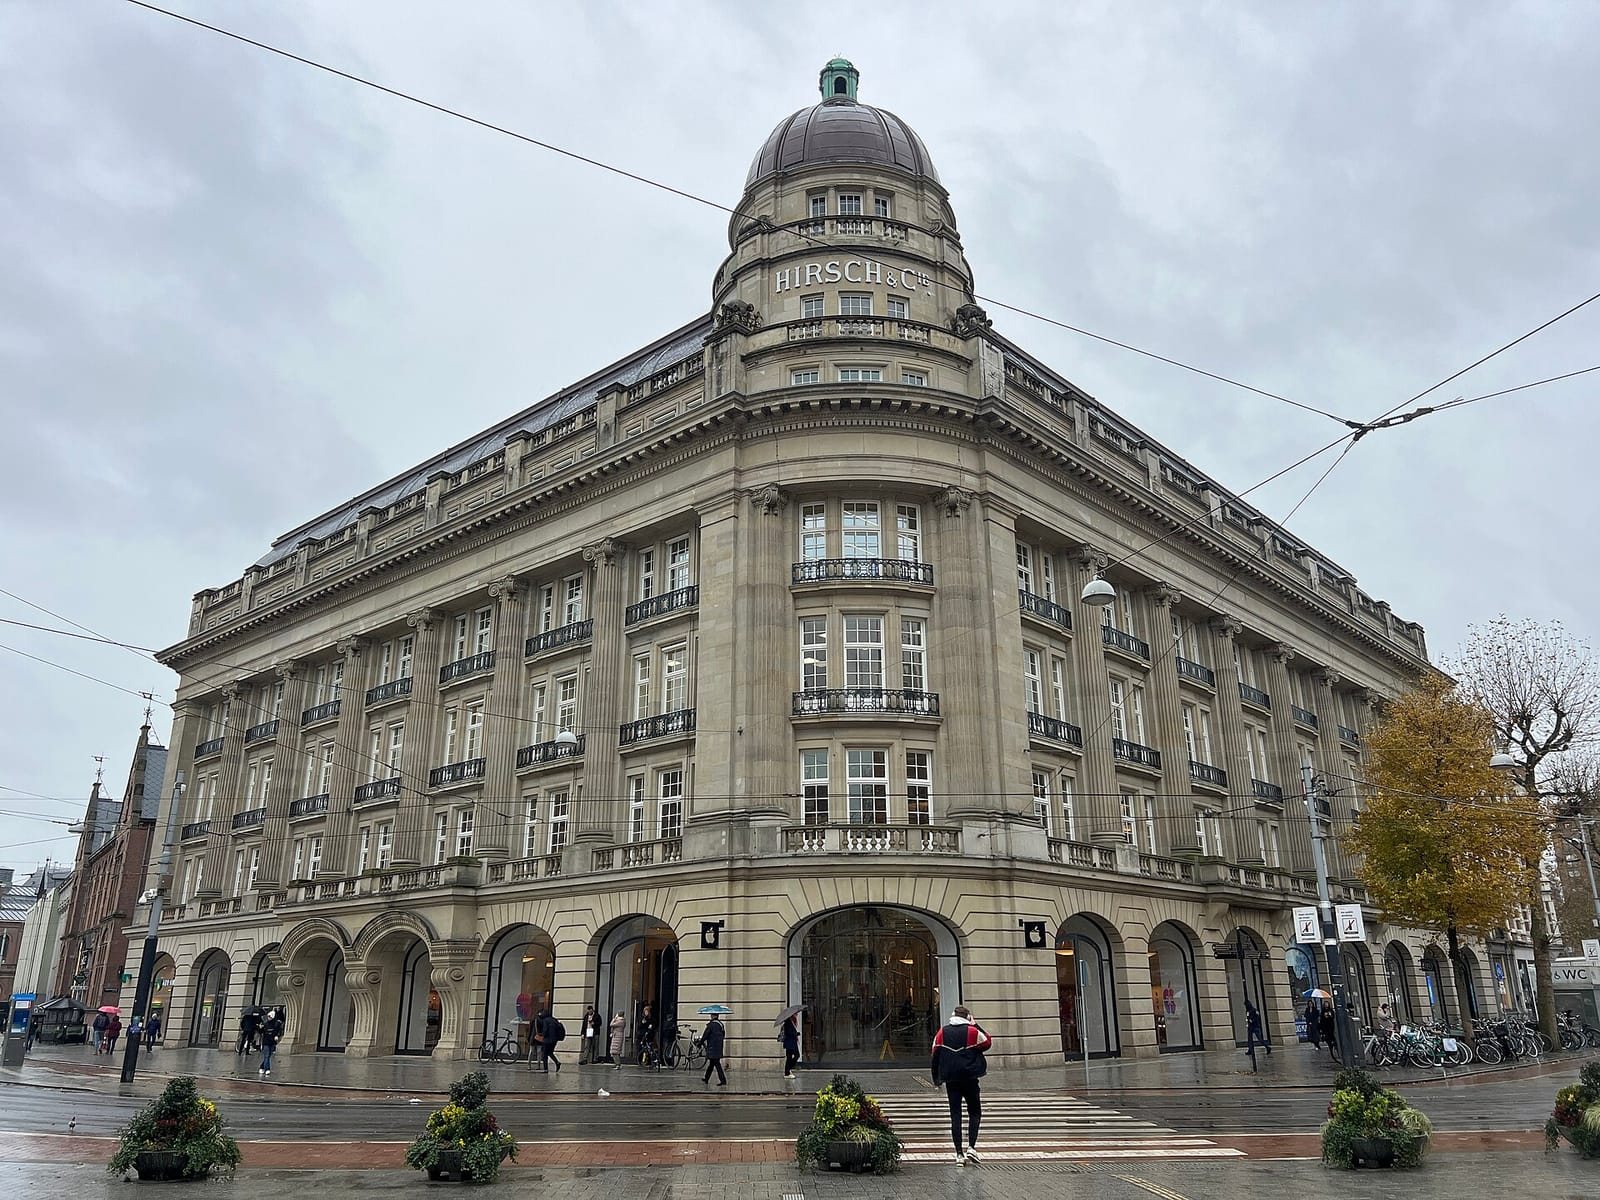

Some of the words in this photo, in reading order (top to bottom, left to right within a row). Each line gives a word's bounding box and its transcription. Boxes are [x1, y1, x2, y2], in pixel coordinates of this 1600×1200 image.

[775, 260, 882, 293] HIRSCH
[886, 270, 898, 288] &
[1562, 969, 1588, 980] WC
